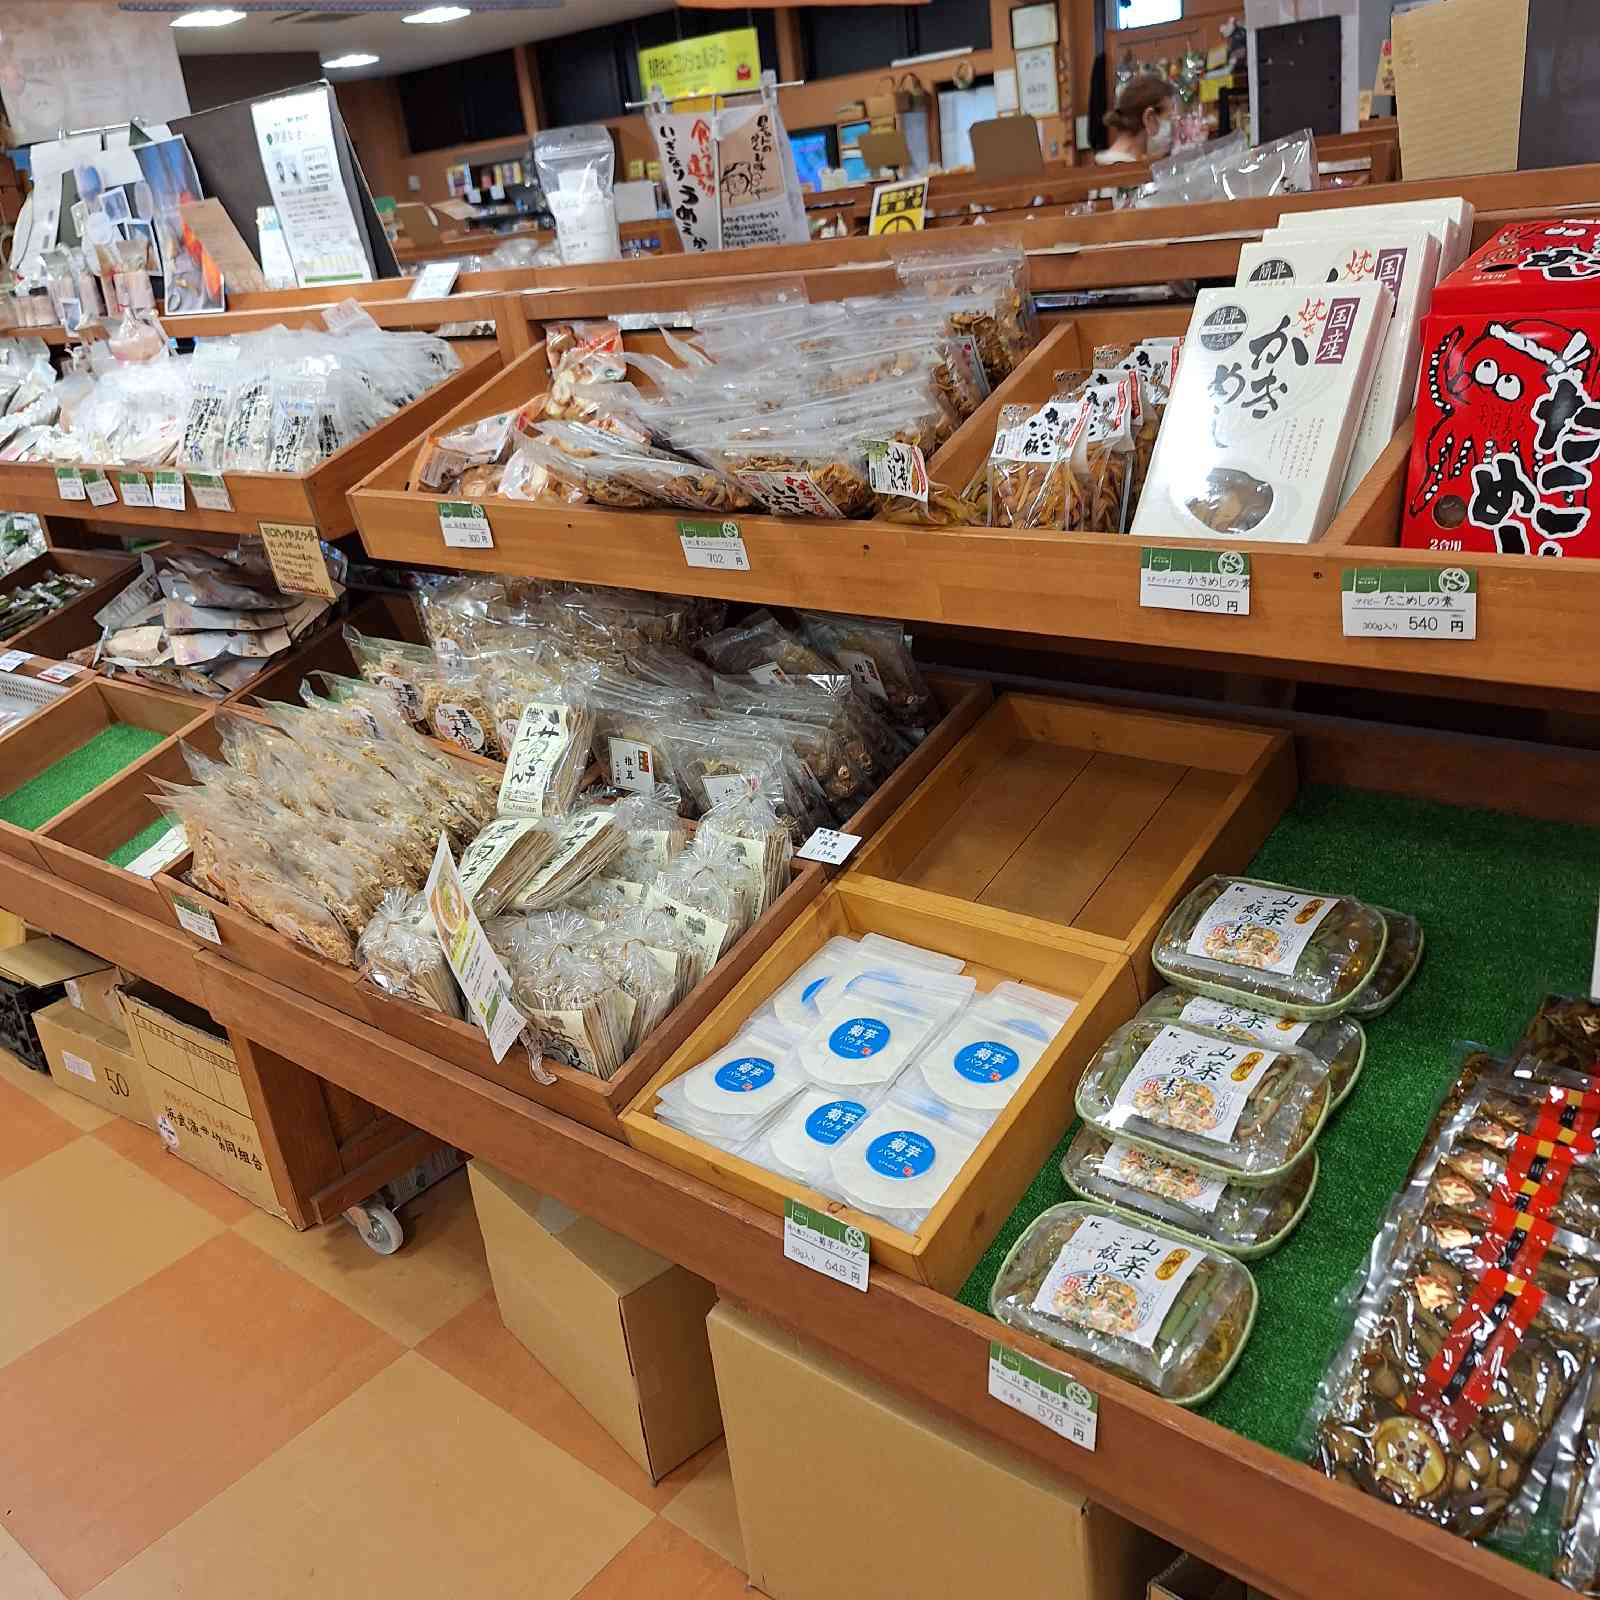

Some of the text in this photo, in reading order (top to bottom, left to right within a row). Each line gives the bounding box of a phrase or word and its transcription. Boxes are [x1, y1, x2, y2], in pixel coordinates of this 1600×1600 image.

[1297, 298, 1328, 338] 焼き
[1317, 303, 1356, 363] 国産
[1241, 313, 1311, 420] かき
[1187, 575, 1249, 591] かきめしの素
[1191, 593, 1238, 613] 1080 円
[1384, 594, 1454, 608] たこめしの素
[1408, 616, 1438, 631] 540
[1451, 620, 1464, 633] 円
[1263, 895, 1300, 926] 山菜
[848, 1023, 880, 1040] 菊芋
[975, 1046, 1006, 1065] 菊芋
[1192, 1046, 1236, 1082] 山菜
[738, 1061, 764, 1077] 菊芋
[1160, 1044, 1205, 1097] ご飯の素
[106, 1066, 129, 1098] 50
[826, 1108, 858, 1126] 菊芋
[886, 1137, 922, 1159] 菊芋
[825, 1259, 847, 1278] 648
[1079, 1235, 1130, 1296] ご飯の素
[1113, 1239, 1161, 1280] 山菜
